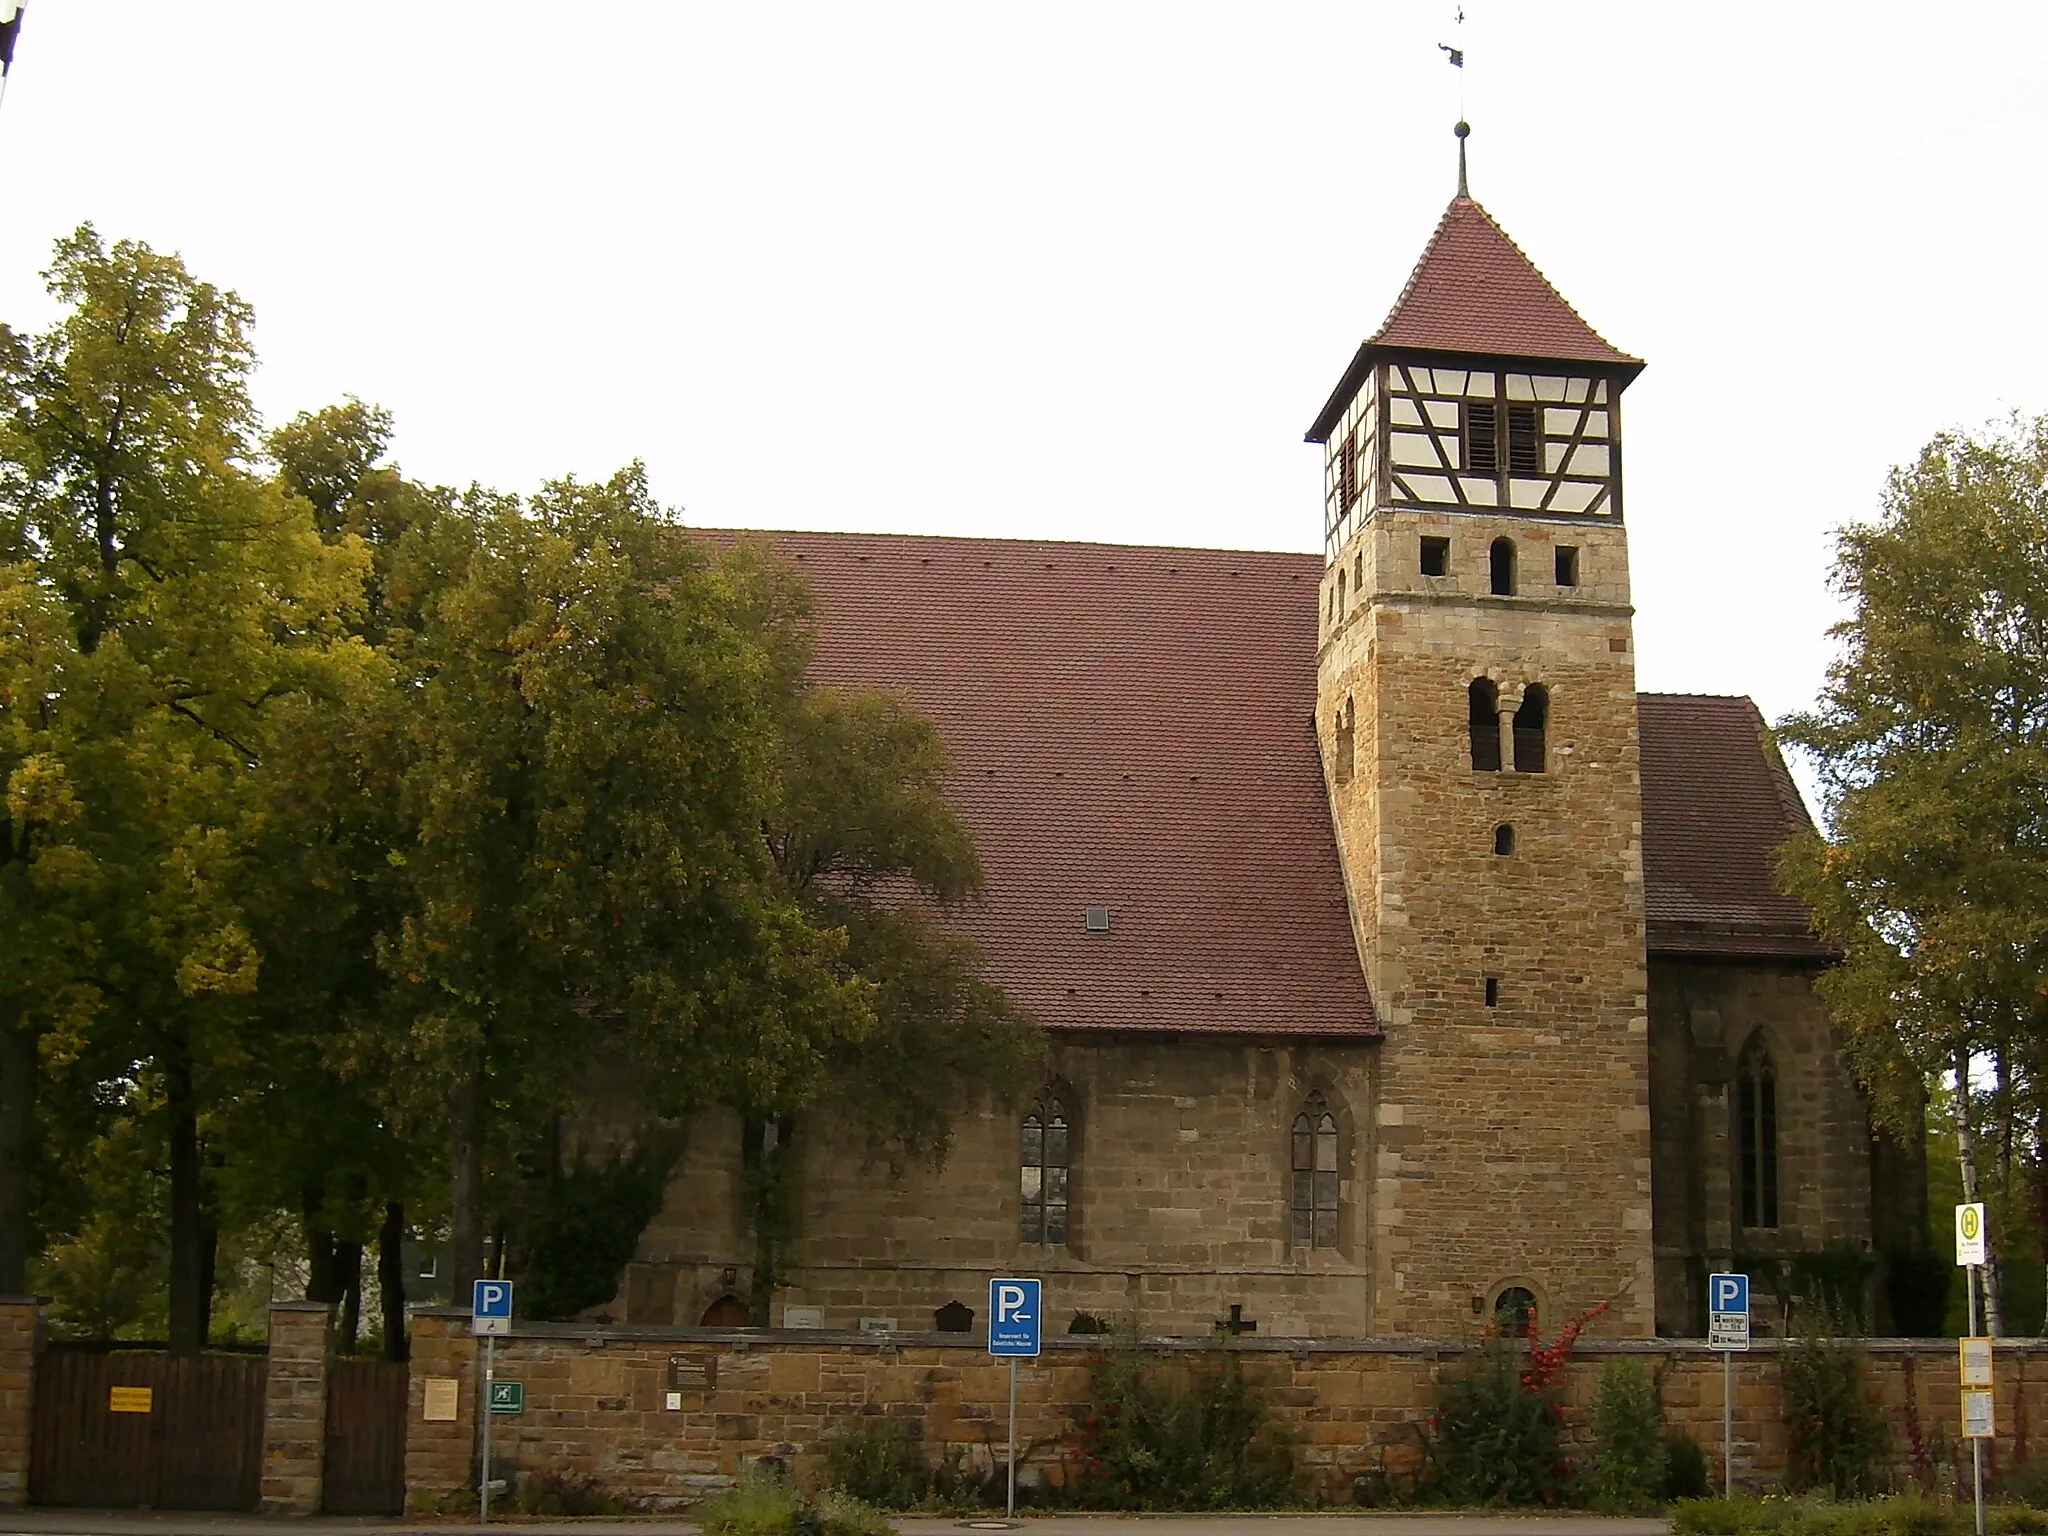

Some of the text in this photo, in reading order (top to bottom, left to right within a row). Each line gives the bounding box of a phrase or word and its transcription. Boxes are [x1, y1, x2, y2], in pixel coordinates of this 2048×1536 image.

[1966, 1214, 1973, 1232] H
[483, 1286, 503, 1312] P
[998, 1286, 1025, 1323] P
[1719, 1280, 1739, 1310] P
